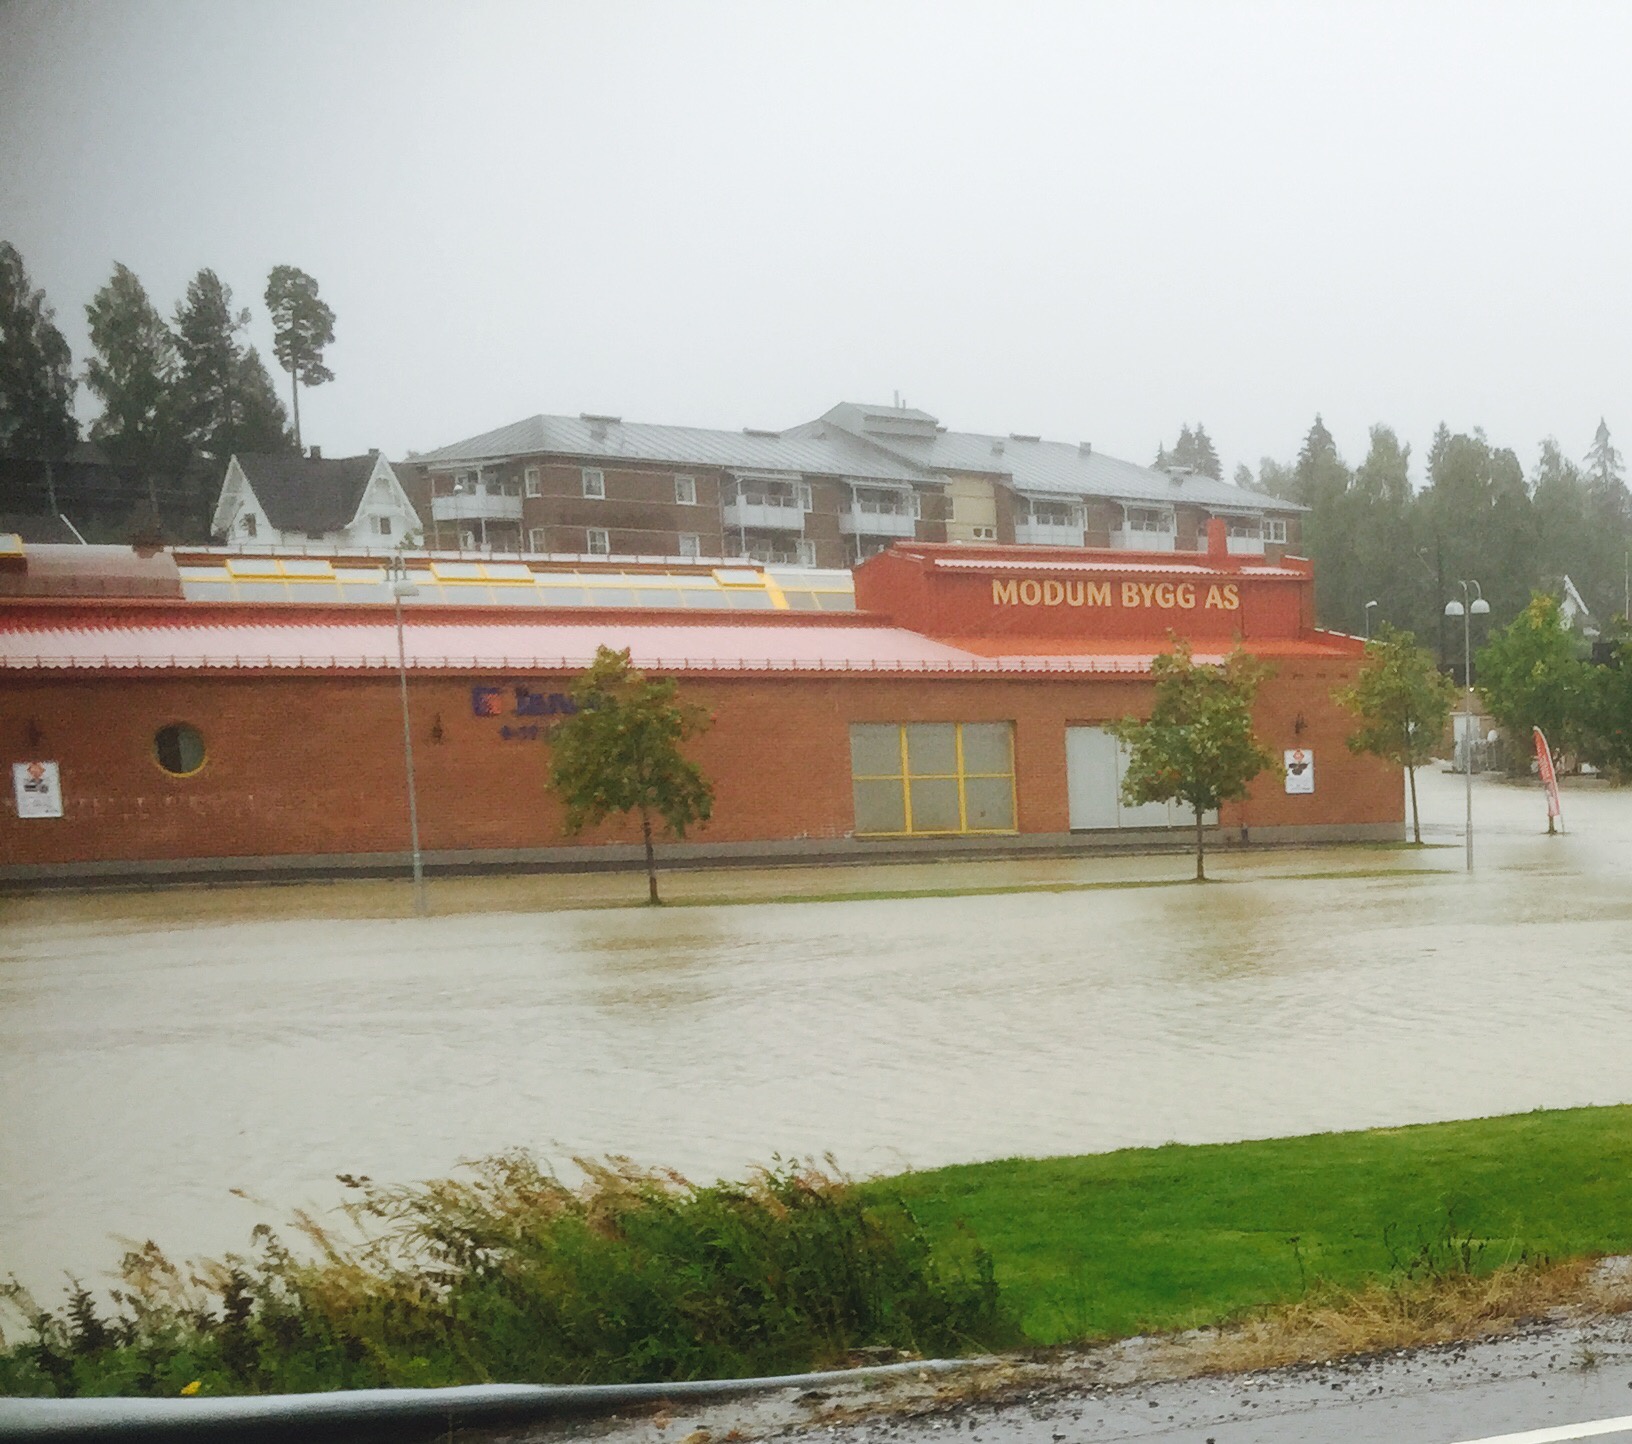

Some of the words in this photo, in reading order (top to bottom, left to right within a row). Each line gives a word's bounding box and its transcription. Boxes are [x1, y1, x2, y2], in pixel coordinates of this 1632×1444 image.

[992, 579, 1112, 606] MODUM
[1122, 582, 1196, 609] BYGG
[1204, 583, 1240, 610] AS
